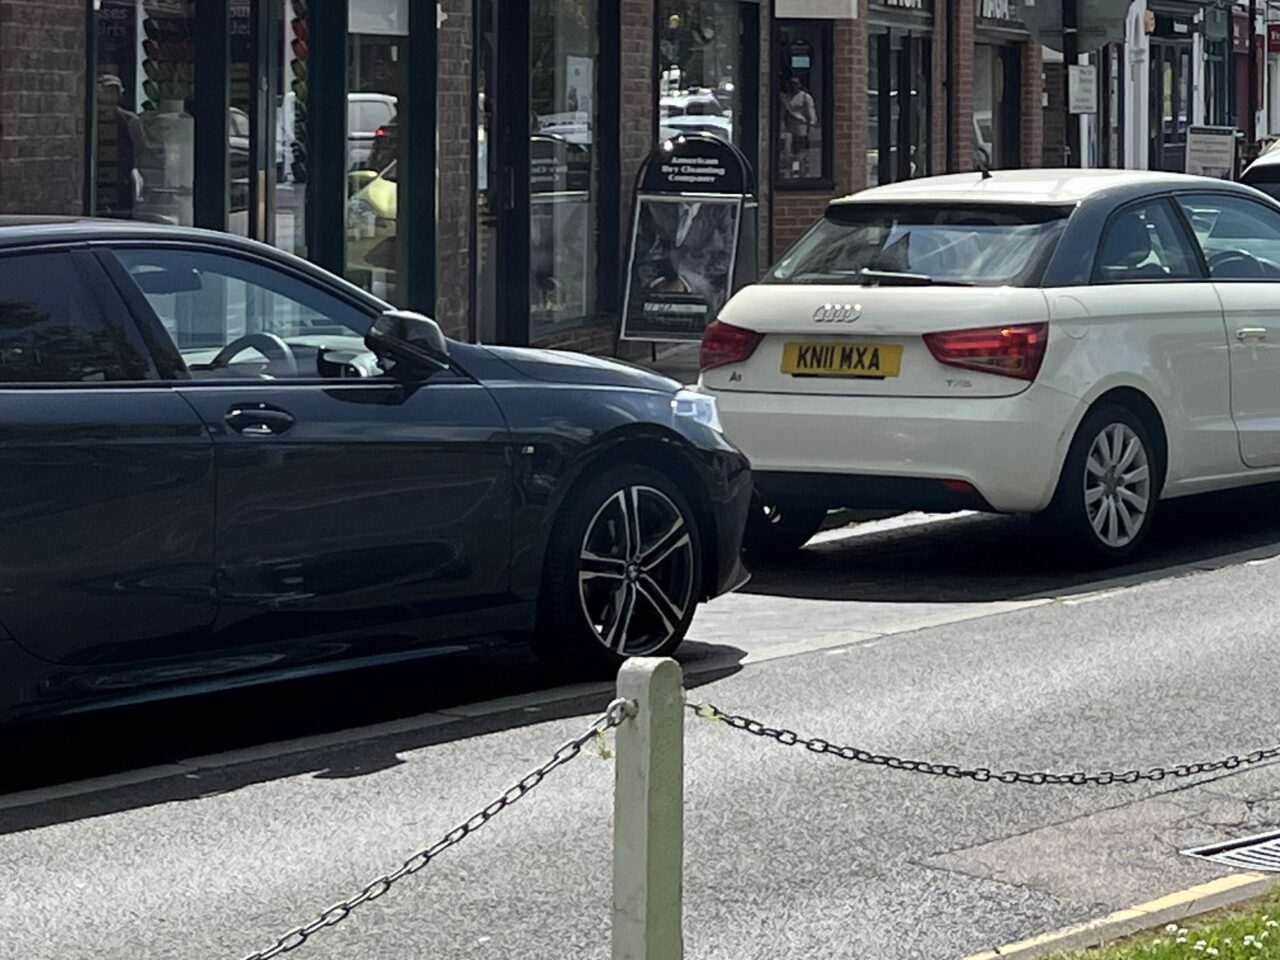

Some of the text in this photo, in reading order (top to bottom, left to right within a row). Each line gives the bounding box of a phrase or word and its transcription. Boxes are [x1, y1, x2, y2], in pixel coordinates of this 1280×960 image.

[671, 156, 719, 165] American
[661, 165, 726, 176] Dry Cleaning
[668, 174, 716, 183] Company
[796, 345, 880, 371] KN11 MXA
